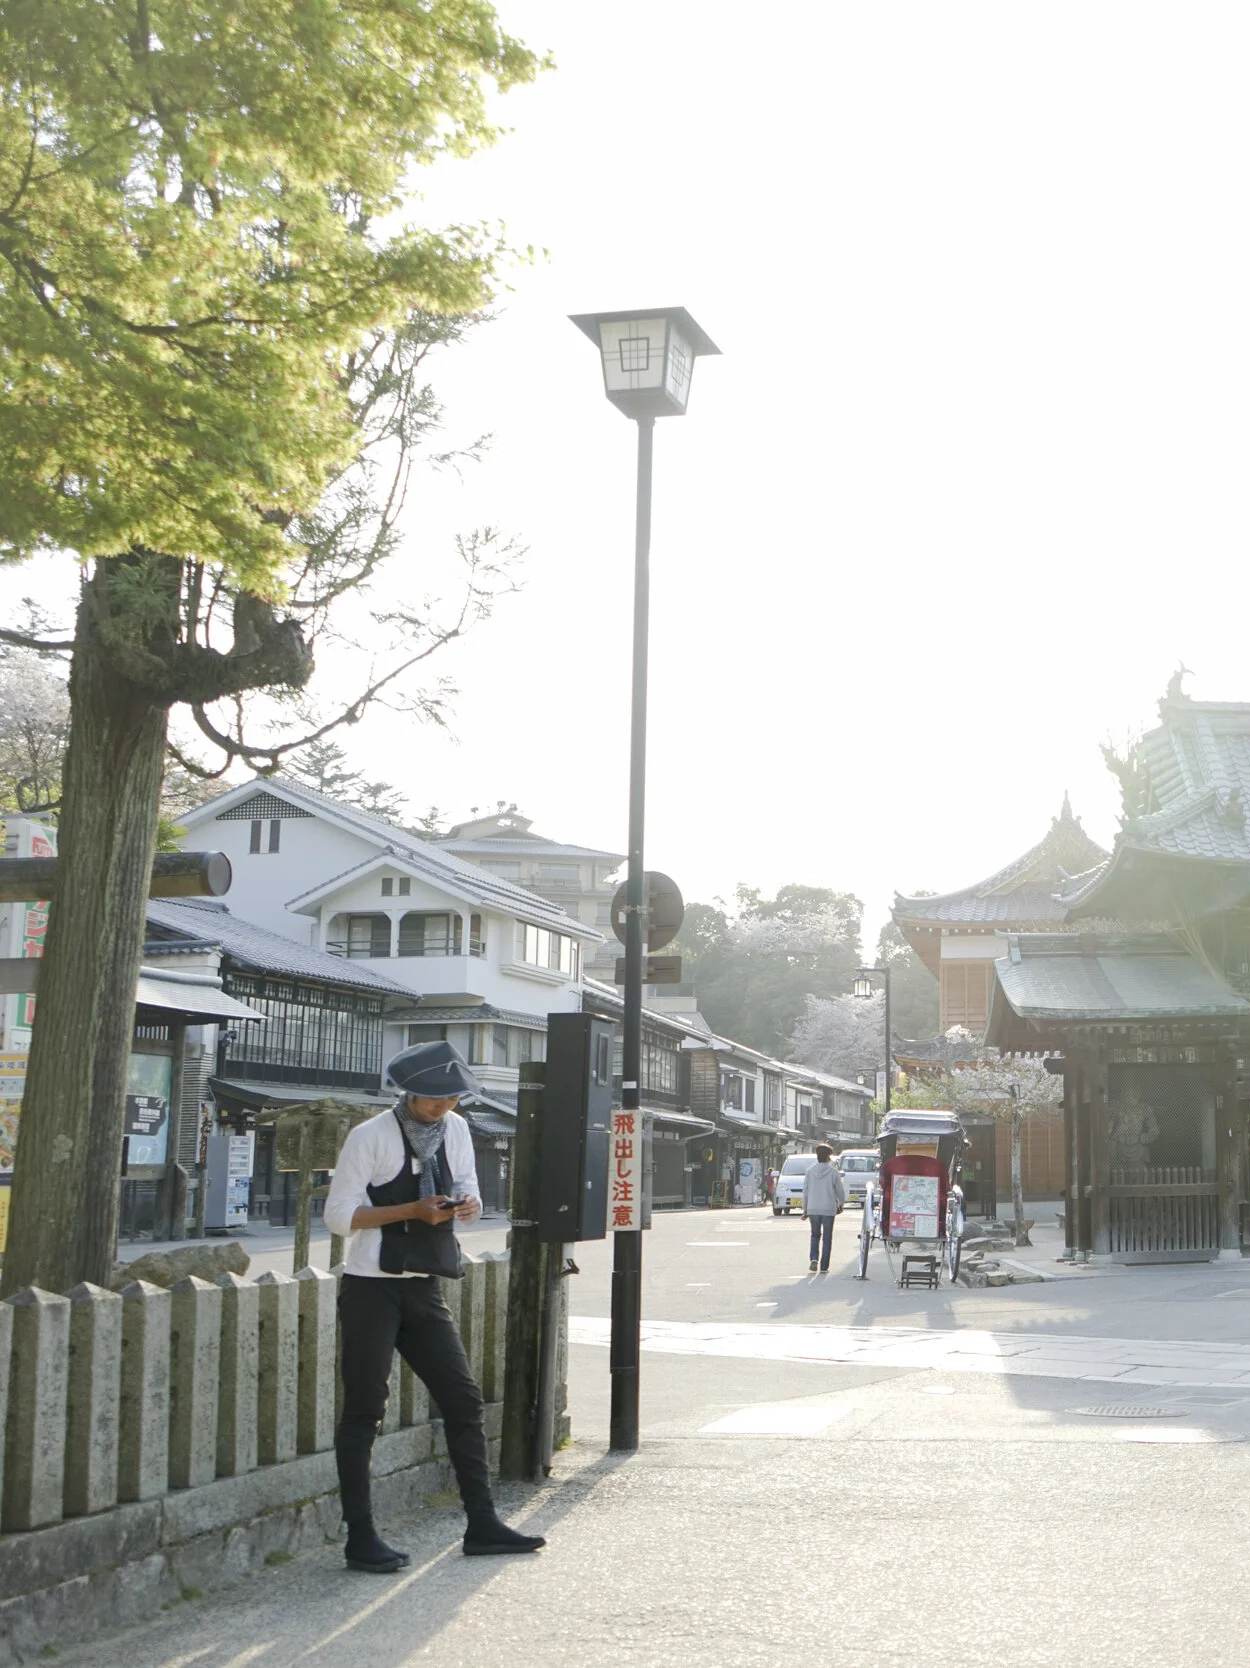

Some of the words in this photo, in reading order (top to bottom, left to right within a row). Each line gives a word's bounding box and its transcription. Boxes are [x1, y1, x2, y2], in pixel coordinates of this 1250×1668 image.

[612, 1113, 635, 1227] 飛出し注意
